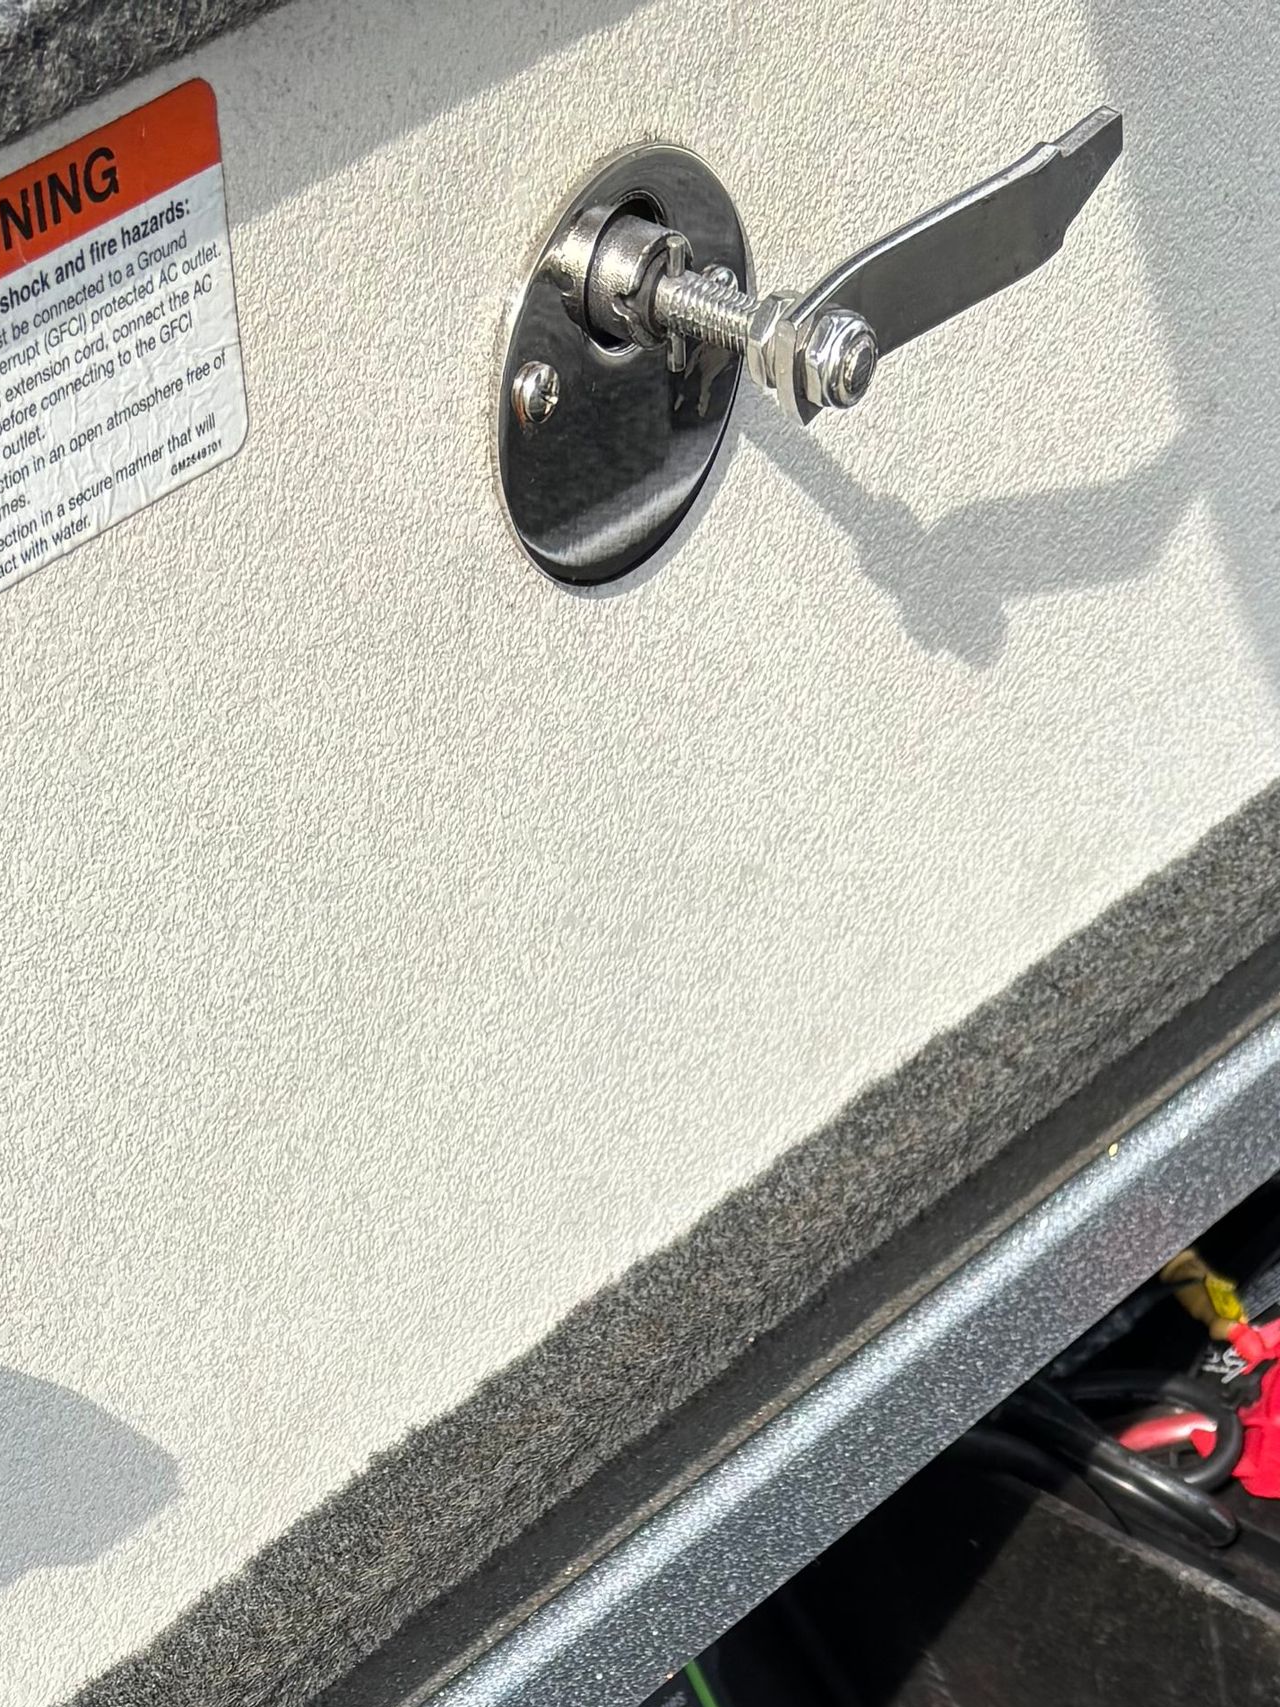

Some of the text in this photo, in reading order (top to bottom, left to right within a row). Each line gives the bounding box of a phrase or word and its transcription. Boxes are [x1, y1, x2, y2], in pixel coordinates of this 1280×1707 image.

[54, 248, 85, 284] and
[89, 237, 117, 265] fire
[120, 199, 189, 248] hazards:
